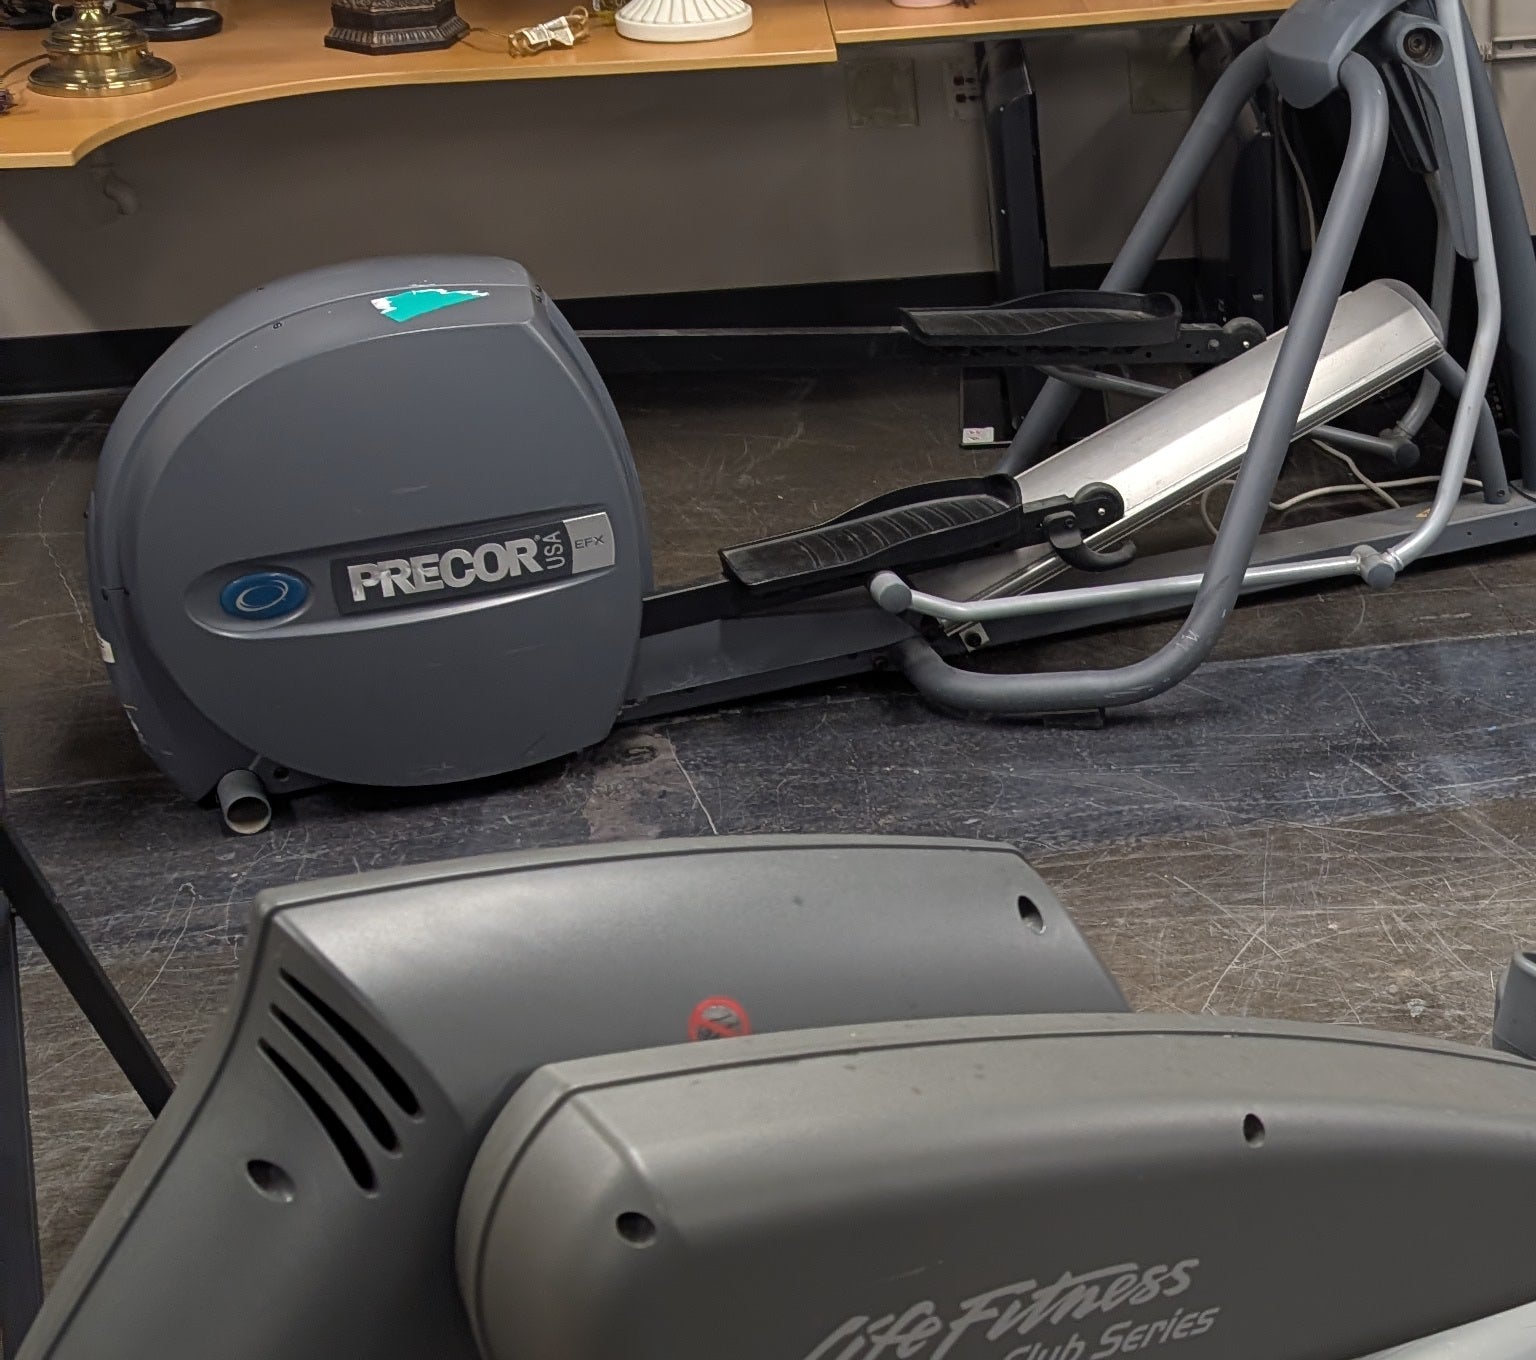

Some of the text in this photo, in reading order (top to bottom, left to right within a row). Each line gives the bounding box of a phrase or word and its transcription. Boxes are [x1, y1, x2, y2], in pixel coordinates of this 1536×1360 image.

[348, 530, 605, 603] PRECOR USA EFX
